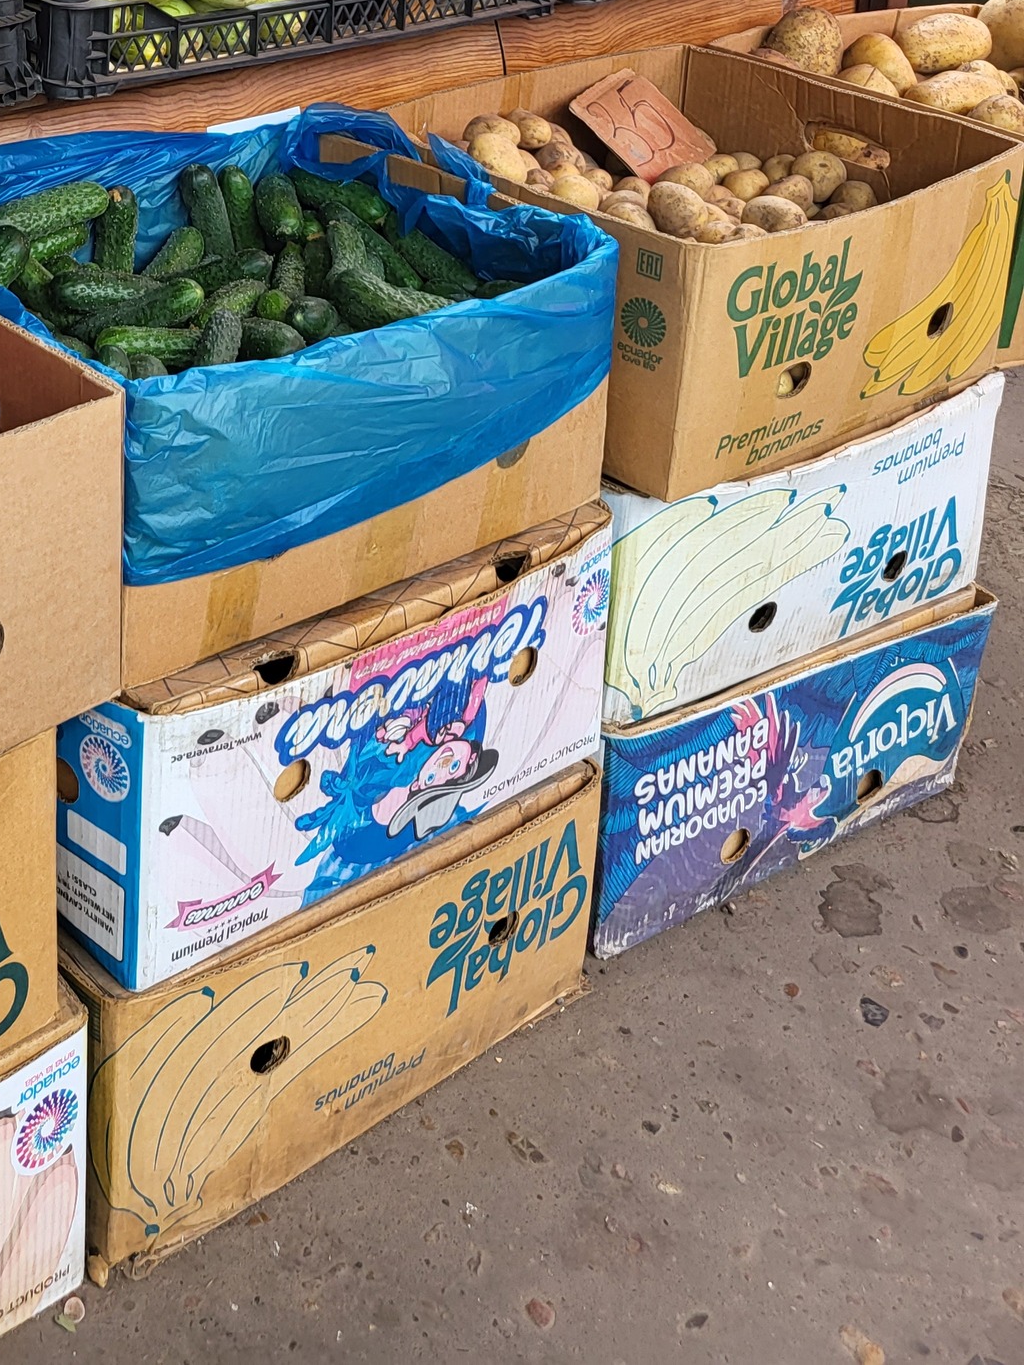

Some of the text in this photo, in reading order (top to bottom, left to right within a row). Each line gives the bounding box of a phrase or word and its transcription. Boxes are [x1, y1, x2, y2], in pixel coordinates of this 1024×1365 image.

[586, 79, 675, 168] 35
[727, 235, 864, 322] Global
[617, 340, 663, 365] ecuador
[621, 350, 641, 367] love
[733, 301, 858, 379] Village
[715, 410, 803, 460] Premium
[745, 418, 825, 466] bananas
[872, 427, 944, 476] bananas
[897, 432, 967, 485] Premium
[839, 495, 959, 585] Village
[829, 547, 962, 640] Global
[281, 602, 545, 758] Terravera
[79, 711, 130, 745] ecuador
[831, 693, 957, 780] Victoria
[482, 732, 596, 800] PRODUCT OF ECUADOR
[634, 717, 769, 805] BANANAS
[638, 749, 767, 835] PREMIUM
[635, 779, 768, 865] ECUADORIAN
[184, 880, 265, 927] Bananas
[429, 819, 582, 947] Village
[171, 906, 269, 963] Tropical Premium
[426, 873, 587, 1017] Global
[17, 1055, 81, 1107] ecuador
[24, 1070, 44, 1087] vida
[54, 1049, 76, 1067] ama
[314, 1051, 396, 1112] bananas
[344, 1047, 426, 1111] Premium
[4, 1263, 70, 1314] PRODUCT
